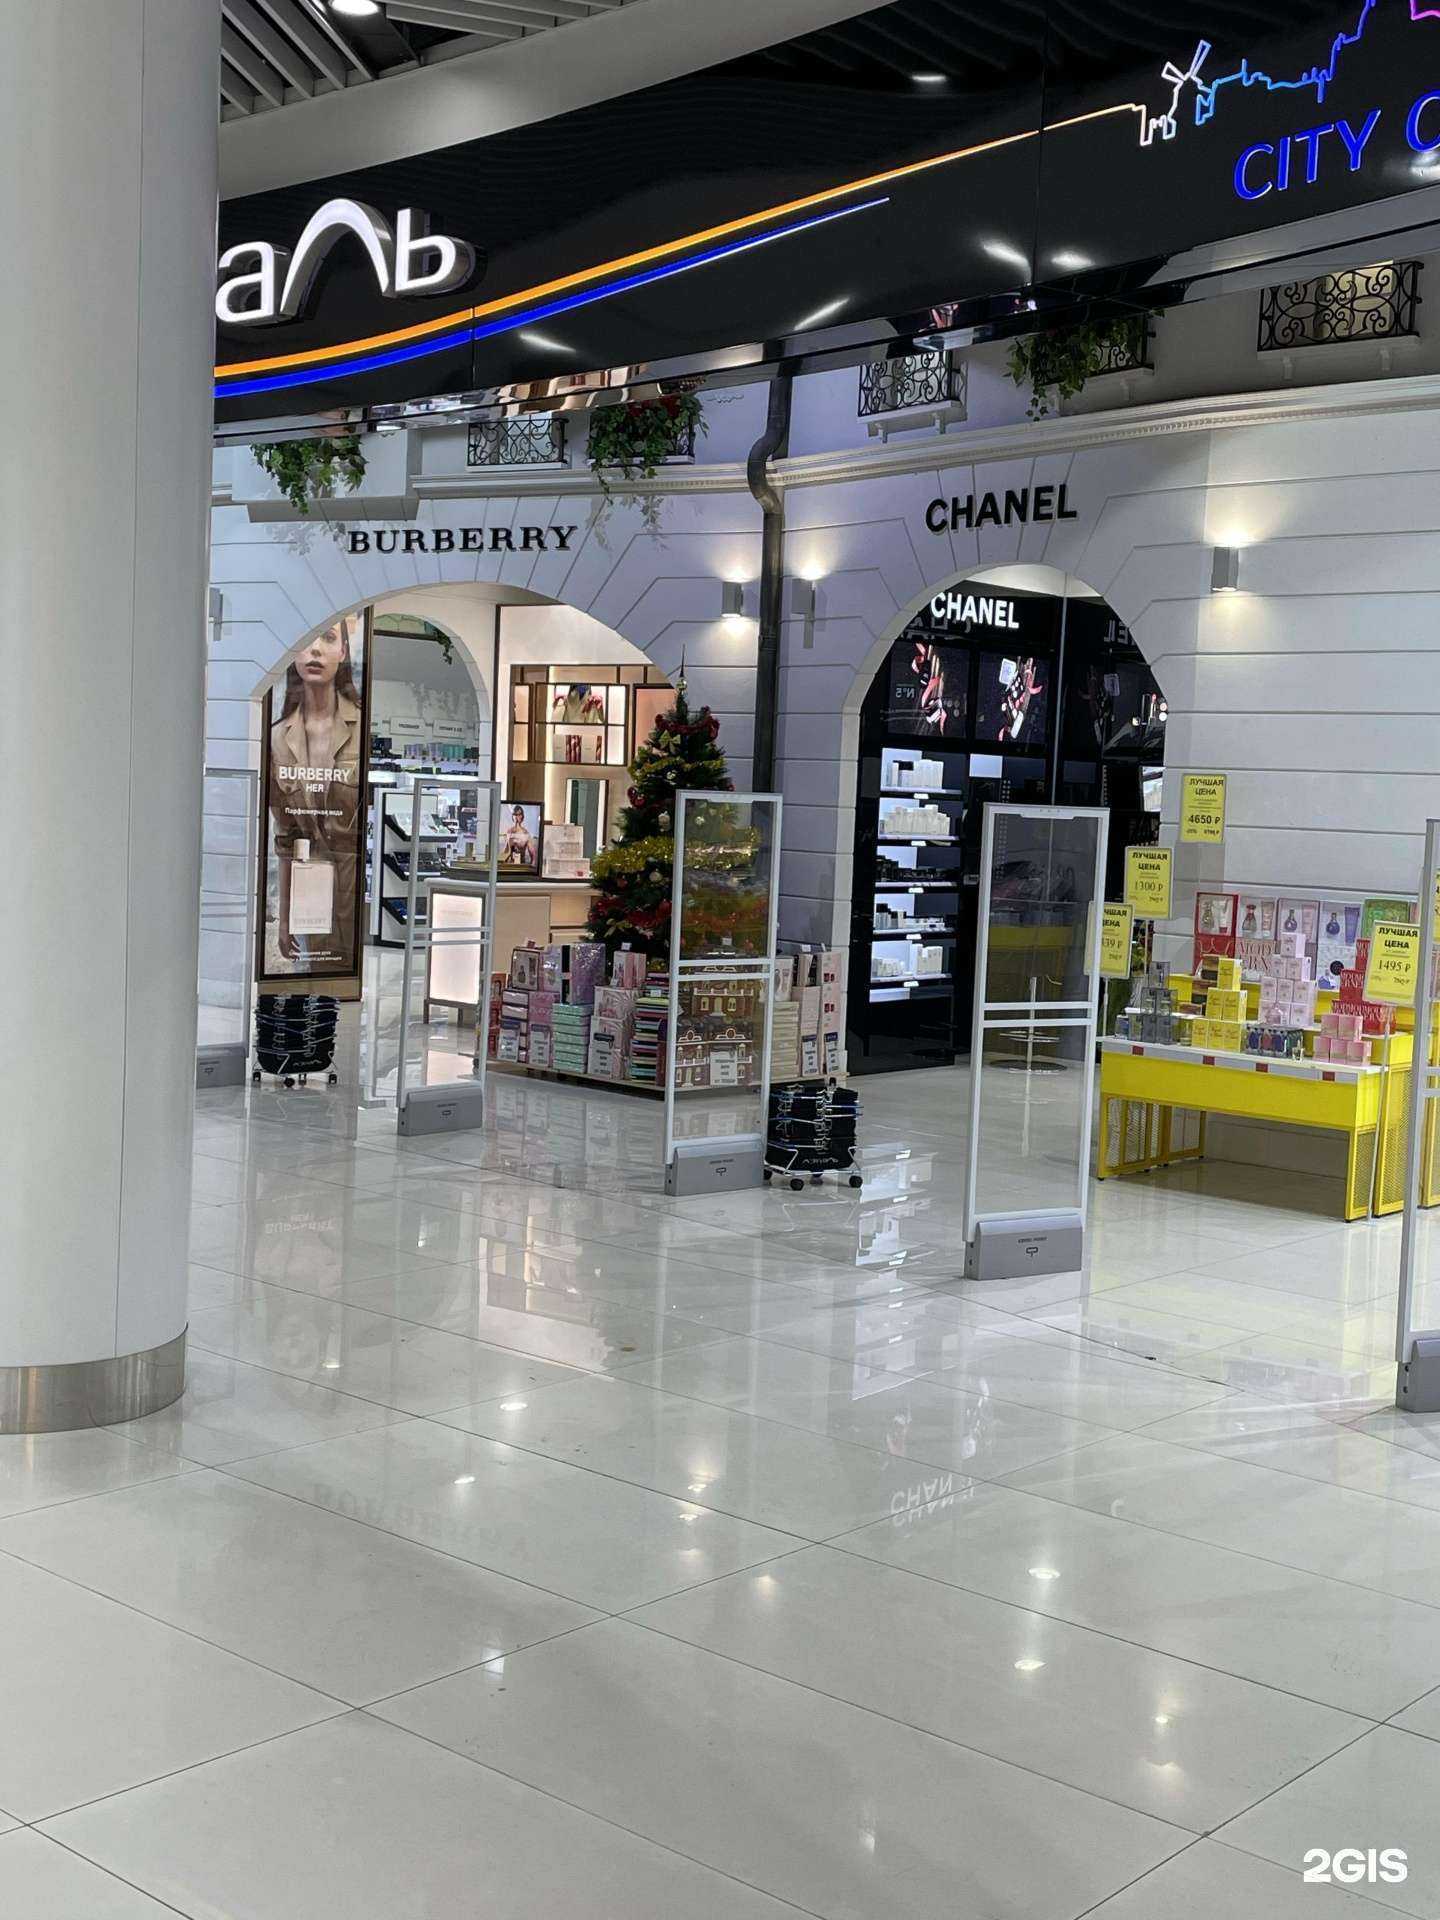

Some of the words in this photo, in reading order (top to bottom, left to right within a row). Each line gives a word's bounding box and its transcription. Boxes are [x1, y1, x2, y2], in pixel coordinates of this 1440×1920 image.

[1234, 109, 1381, 200] CITY
[925, 483, 1078, 533] CHANEL
[347, 525, 578, 554] BURBERRY
[930, 591, 1020, 629] CHANEL
[279, 766, 351, 784] BURBERRY
[1189, 778, 1224, 787] ЛУЧШАЯ
[305, 783, 324, 793] HER
[1195, 788, 1217, 796] ЦЕНА
[1188, 815, 1212, 825] 4650
[1132, 852, 1168, 861] ЛУЧШАЯ
[1138, 863, 1161, 871] ЦЕНА
[1378, 927, 1418, 938] ЛУЧШАЯ
[1384, 939, 1410, 949] ЦЕНА
[1378, 960, 1403, 972] 1495
